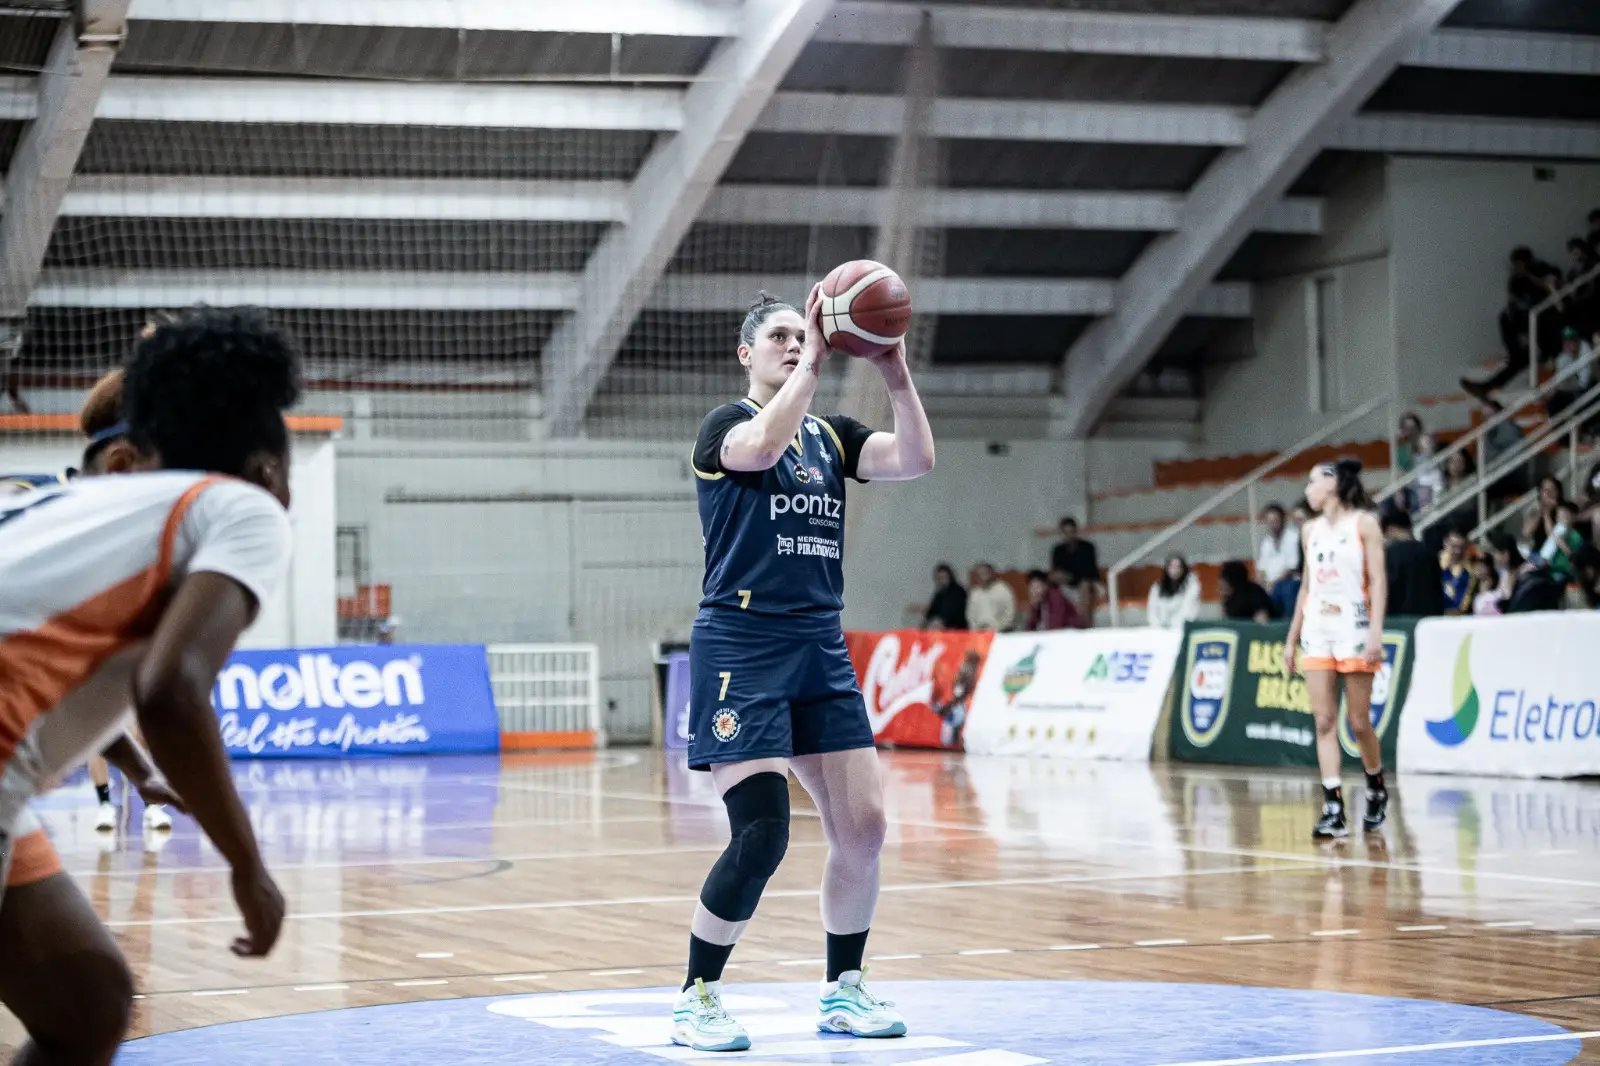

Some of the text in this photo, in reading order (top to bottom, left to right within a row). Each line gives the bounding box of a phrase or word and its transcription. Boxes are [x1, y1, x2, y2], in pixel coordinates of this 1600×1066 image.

[770, 493, 842, 521] pontz
[737, 589, 752, 610] 7
[718, 671, 732, 702] 7
[1489, 690, 1600, 743] Eletro
